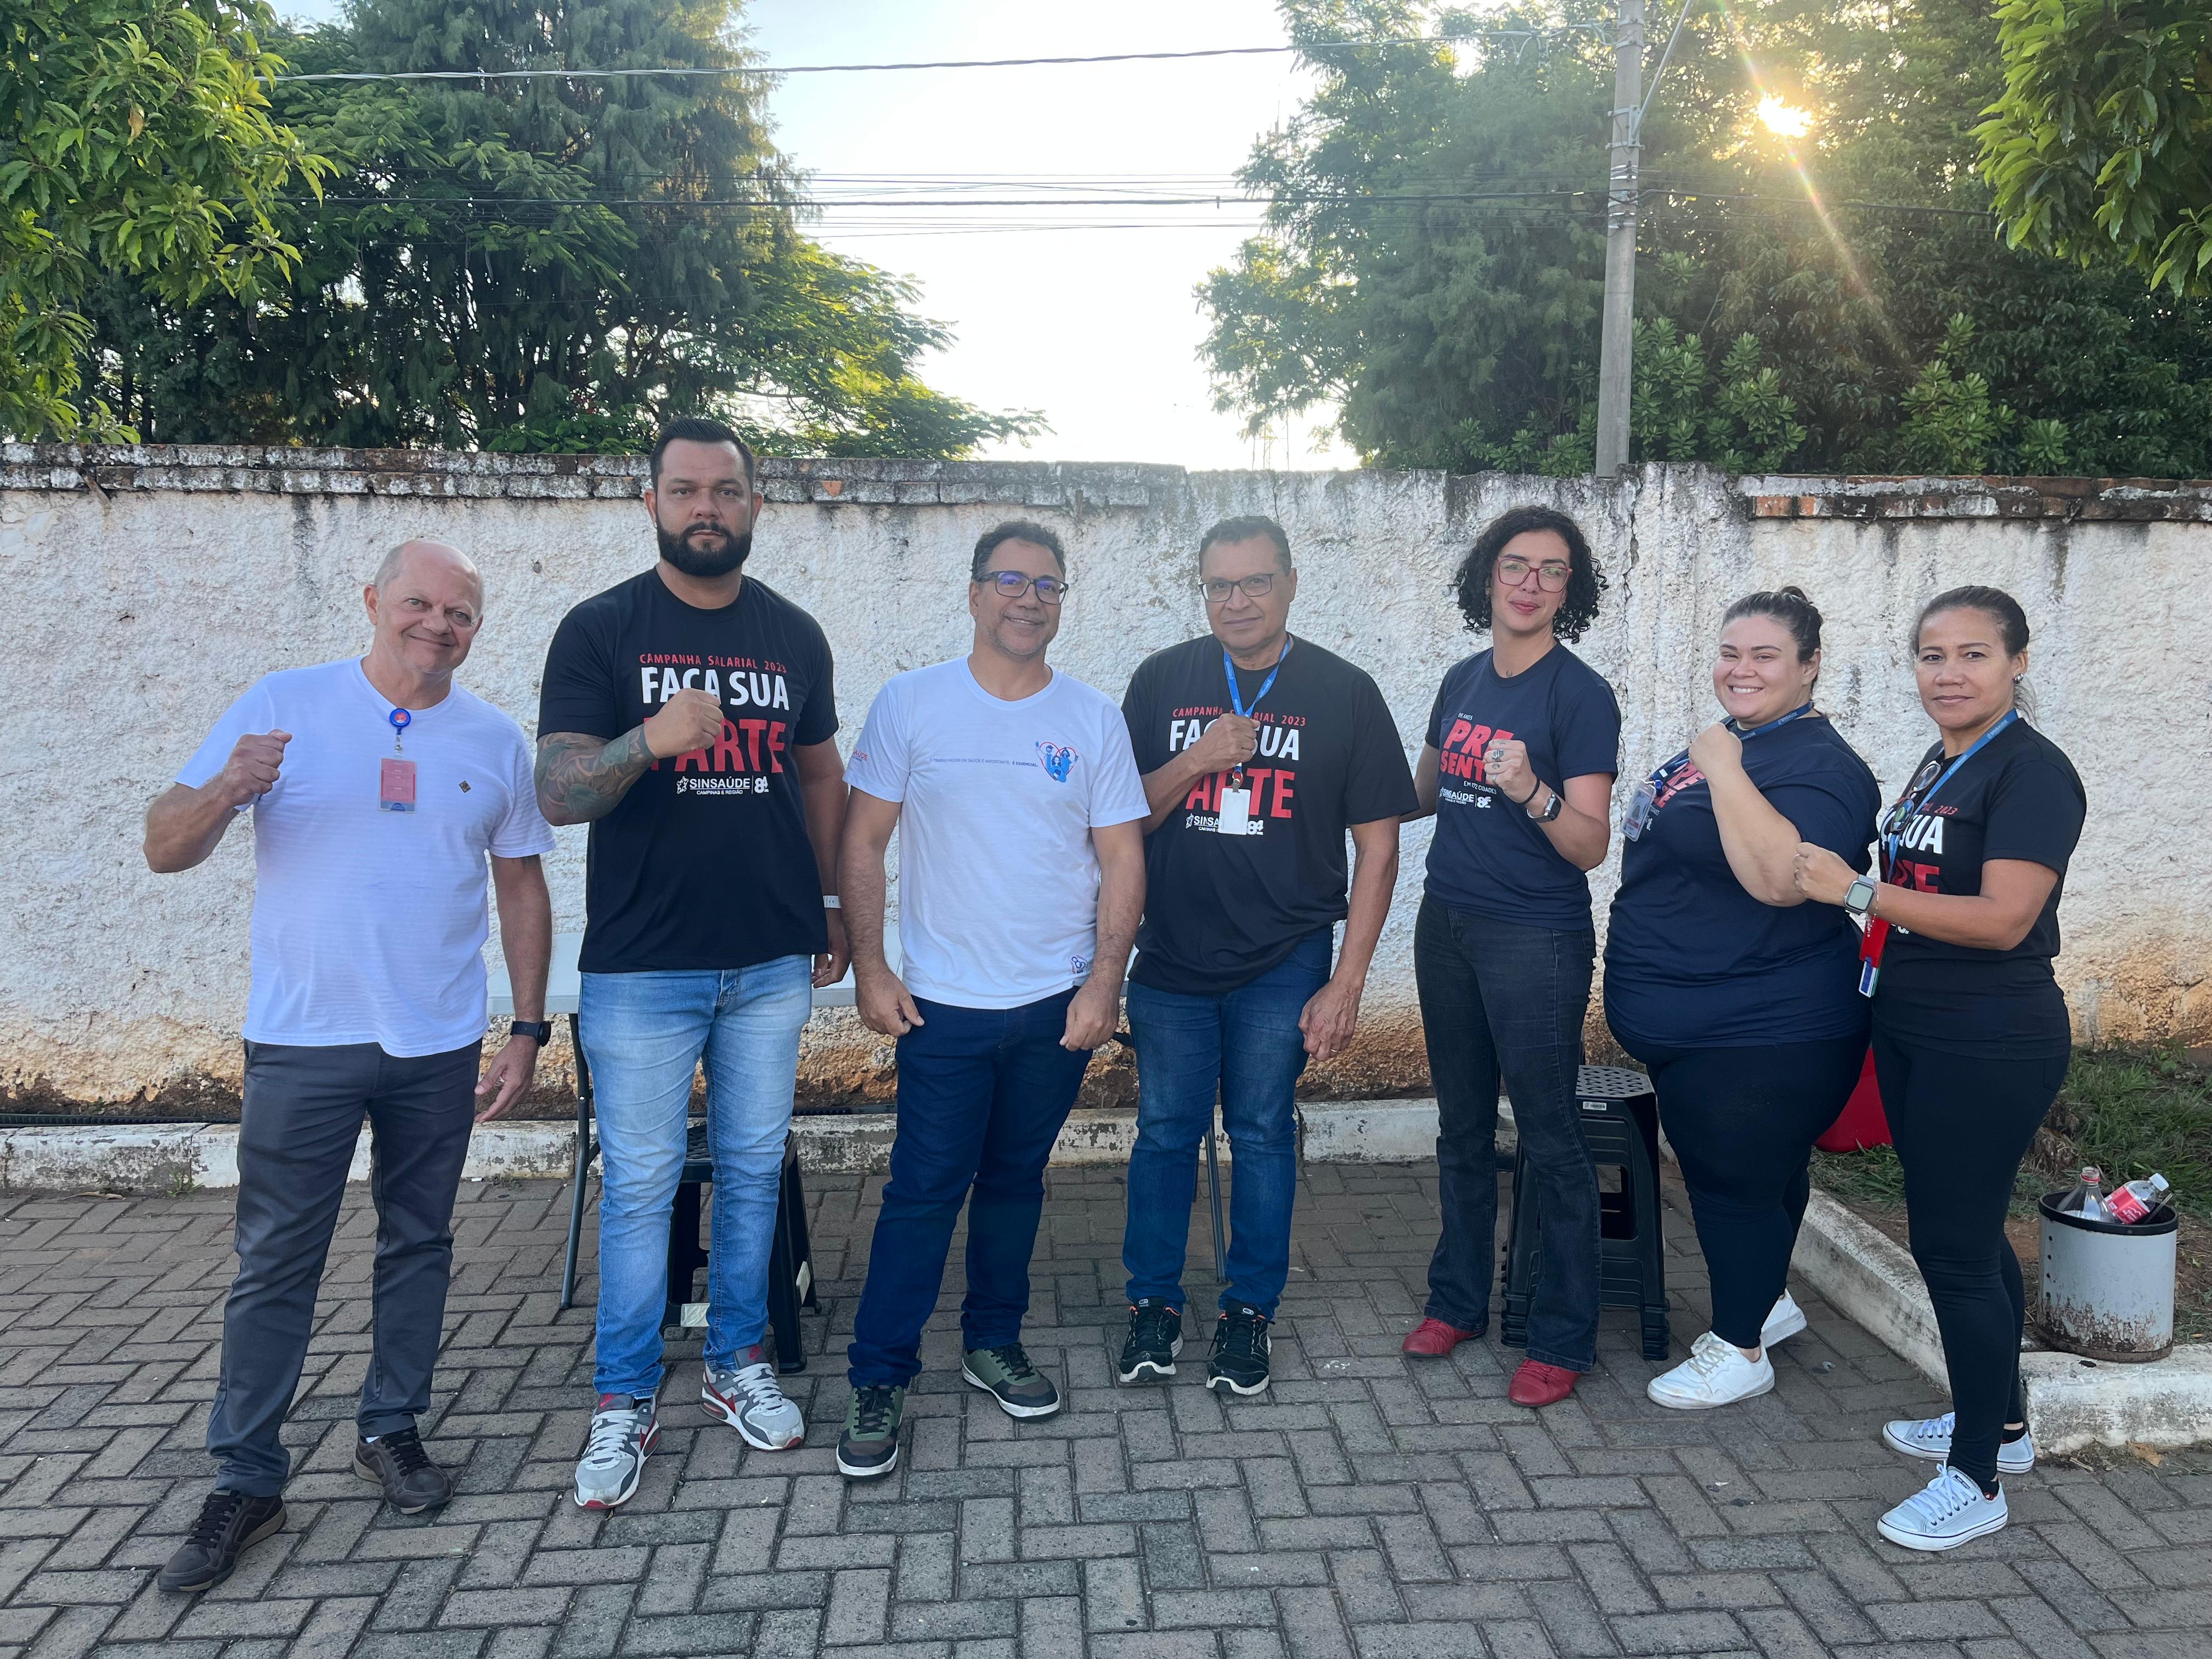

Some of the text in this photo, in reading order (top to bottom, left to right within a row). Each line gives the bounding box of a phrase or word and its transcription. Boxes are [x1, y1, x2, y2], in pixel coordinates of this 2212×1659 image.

[639, 653, 787, 674] CAMPANHA SALARIAL 2023
[729, 670, 790, 711] SUA
[1172, 707, 1223, 718] CAMPANHA
[1282, 715, 1307, 727] 2023
[1252, 725, 1300, 761] UA
[1440, 750, 1491, 785] SENT
[689, 776, 751, 789] SINSAÚDE
[1478, 785, 1497, 795] CIDADES
